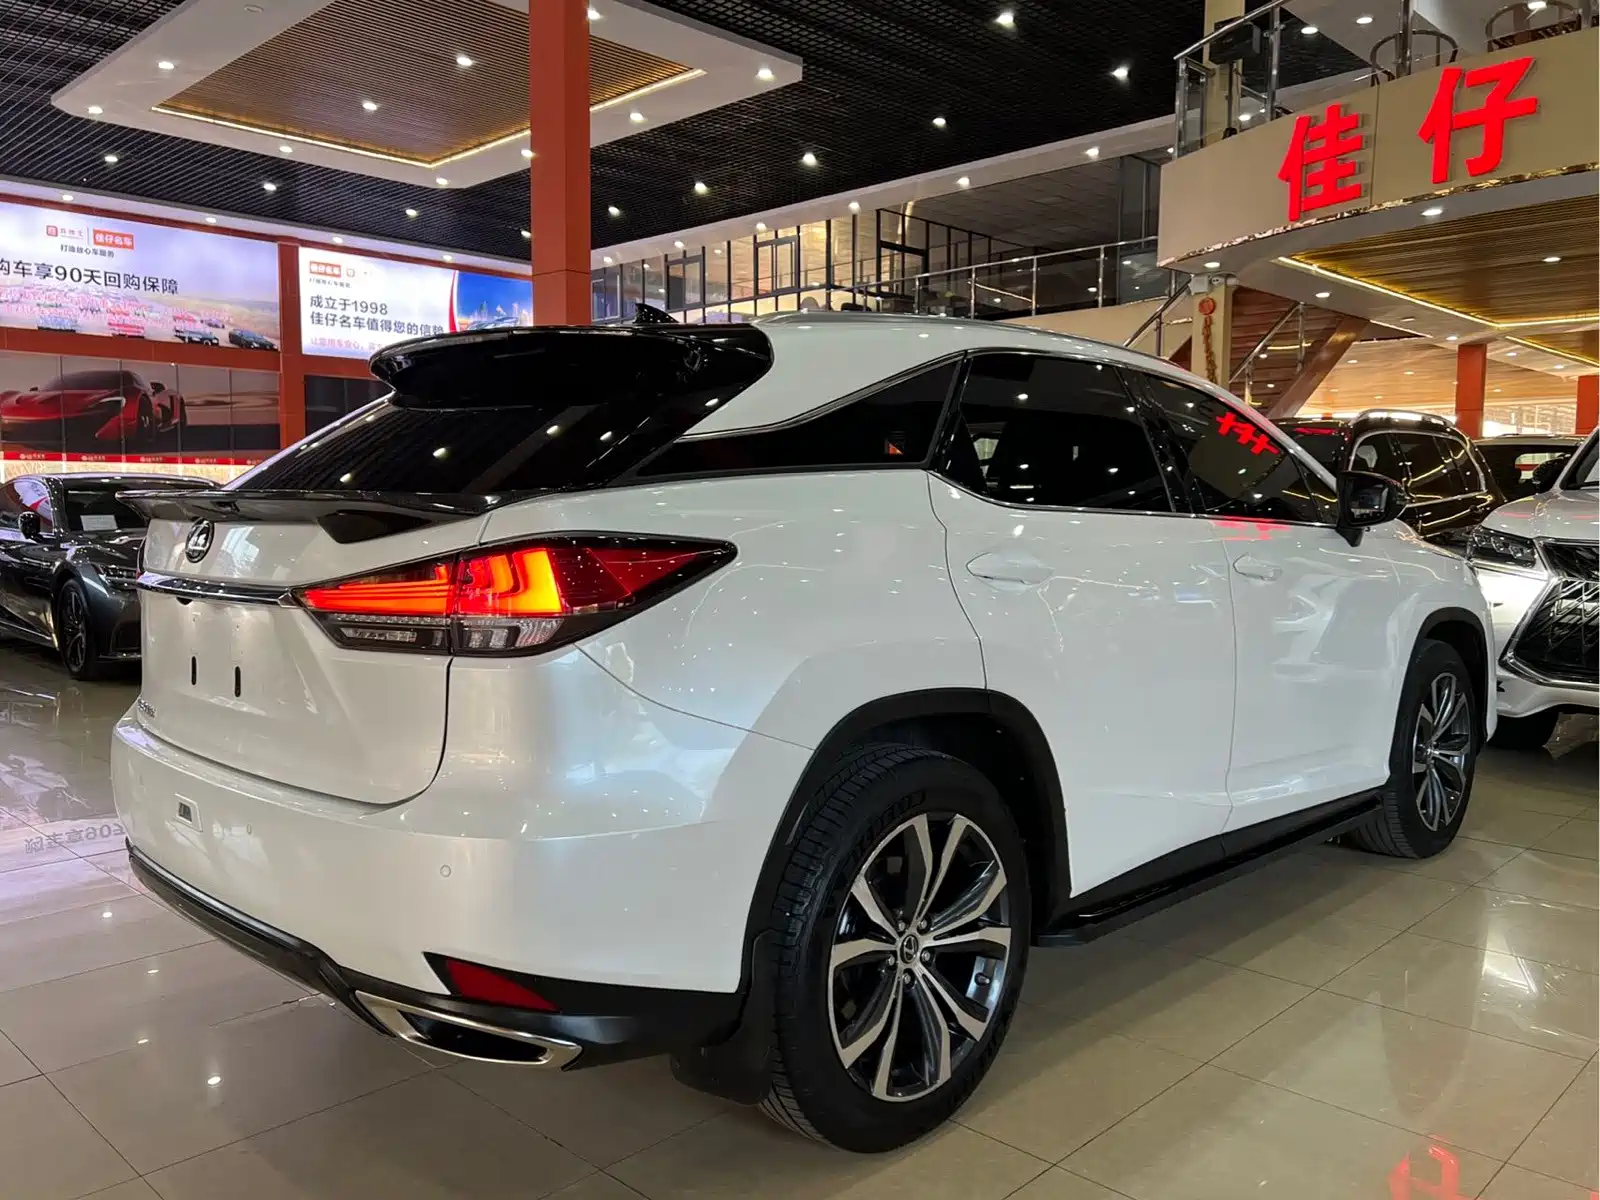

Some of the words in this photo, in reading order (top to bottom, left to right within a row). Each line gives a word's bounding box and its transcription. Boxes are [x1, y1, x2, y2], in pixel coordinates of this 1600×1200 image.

[1278, 57, 1538, 221] 佳仔
[310, 295, 388, 315] 成立于1998
